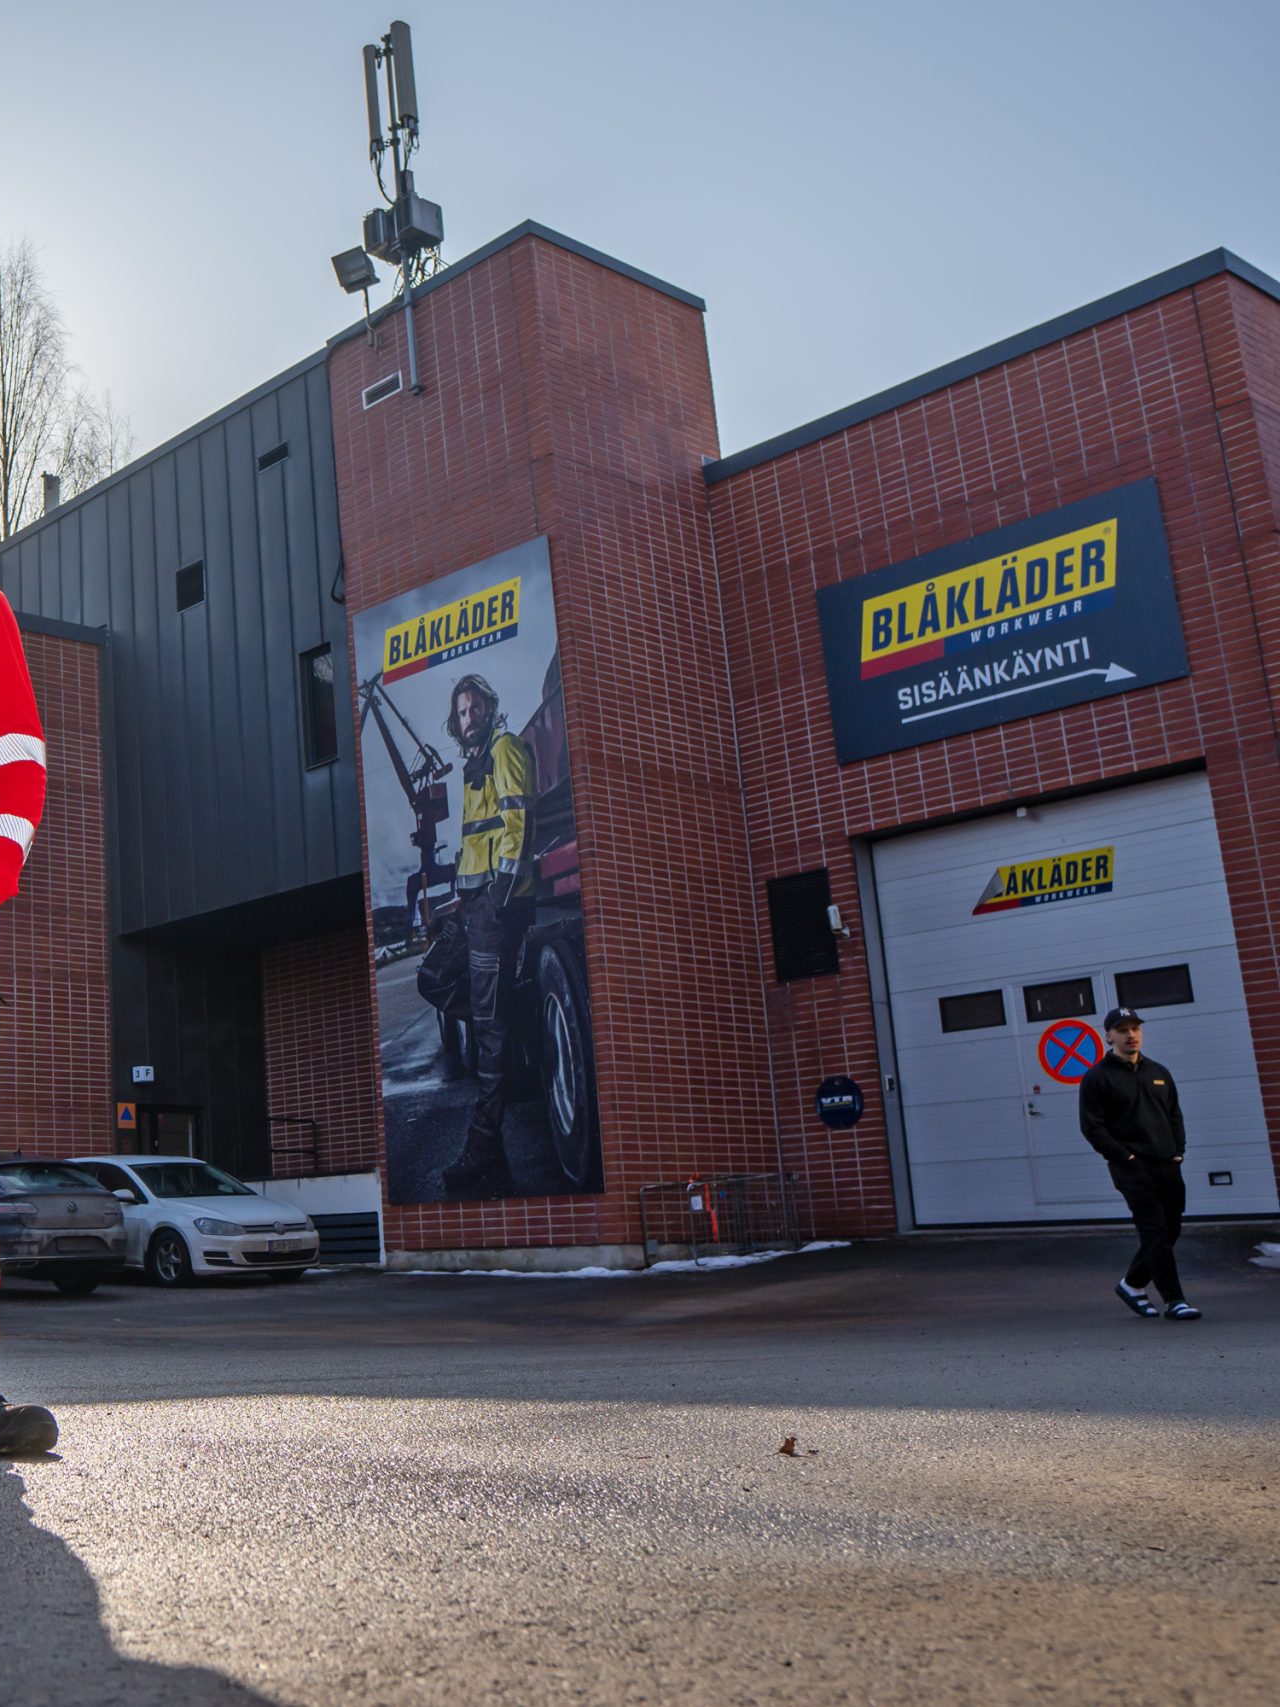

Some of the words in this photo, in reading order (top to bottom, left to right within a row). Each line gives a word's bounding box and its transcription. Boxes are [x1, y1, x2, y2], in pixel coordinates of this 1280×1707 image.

[871, 538, 1108, 652] BLÅKLÄDER
[389, 588, 516, 667] BLÅKLÄDER
[970, 599, 1084, 643] WORKWEAR
[441, 631, 503, 661] WORKWEAR
[897, 636, 1091, 711] SISÄÄNKÄYNTI
[1004, 854, 1109, 897] ÅKLÄDER
[1034, 885, 1097, 903] WORKWEAR
[145, 1068, 151, 1078] F
